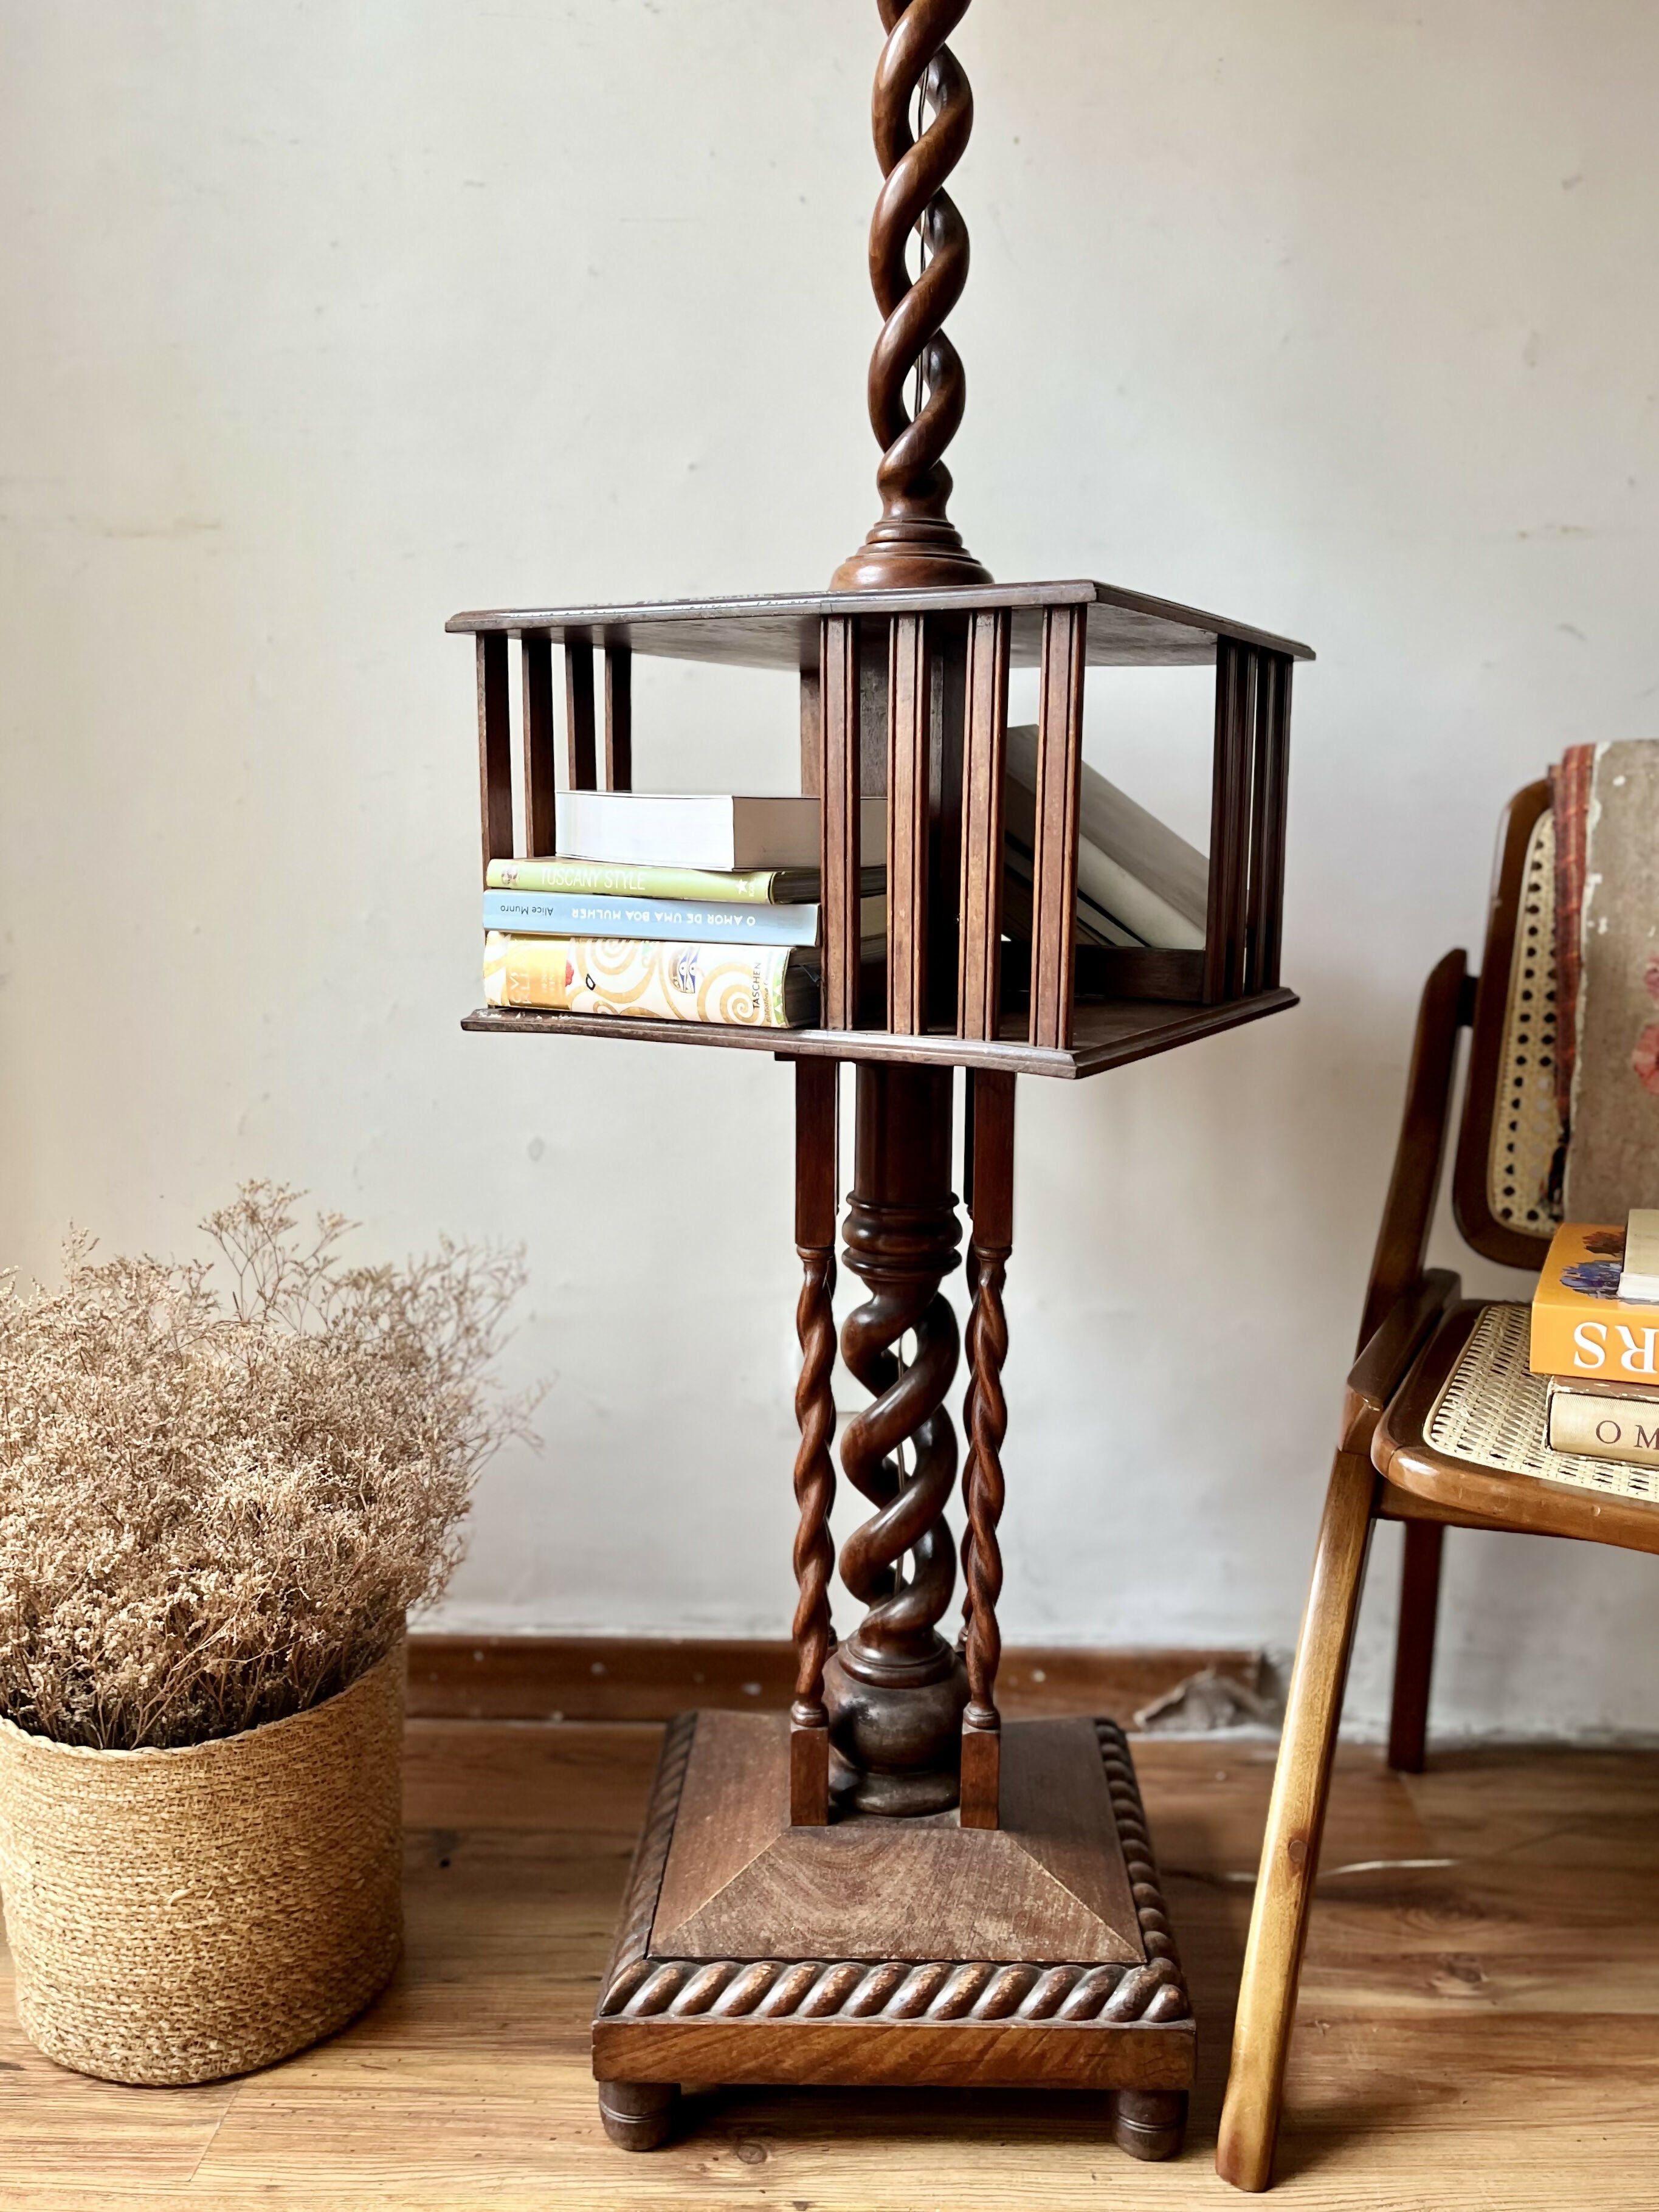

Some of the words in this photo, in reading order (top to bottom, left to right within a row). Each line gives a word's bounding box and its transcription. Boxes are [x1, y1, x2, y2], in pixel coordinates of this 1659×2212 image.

[540, 866, 601, 888] TUSCANY
[604, 869, 646, 891] STYLE
[500, 904, 529, 915] Munro
[532, 906, 554, 916] Alice
[571, 908, 621, 921] MULHER
[626, 910, 650, 922] BOA
[654, 911, 682, 922] UMA
[687, 913, 703, 924] DE
[707, 914, 743, 925] AMOR
[747, 916, 756, 926] O
[752, 962, 761, 1010] TASCHEN
